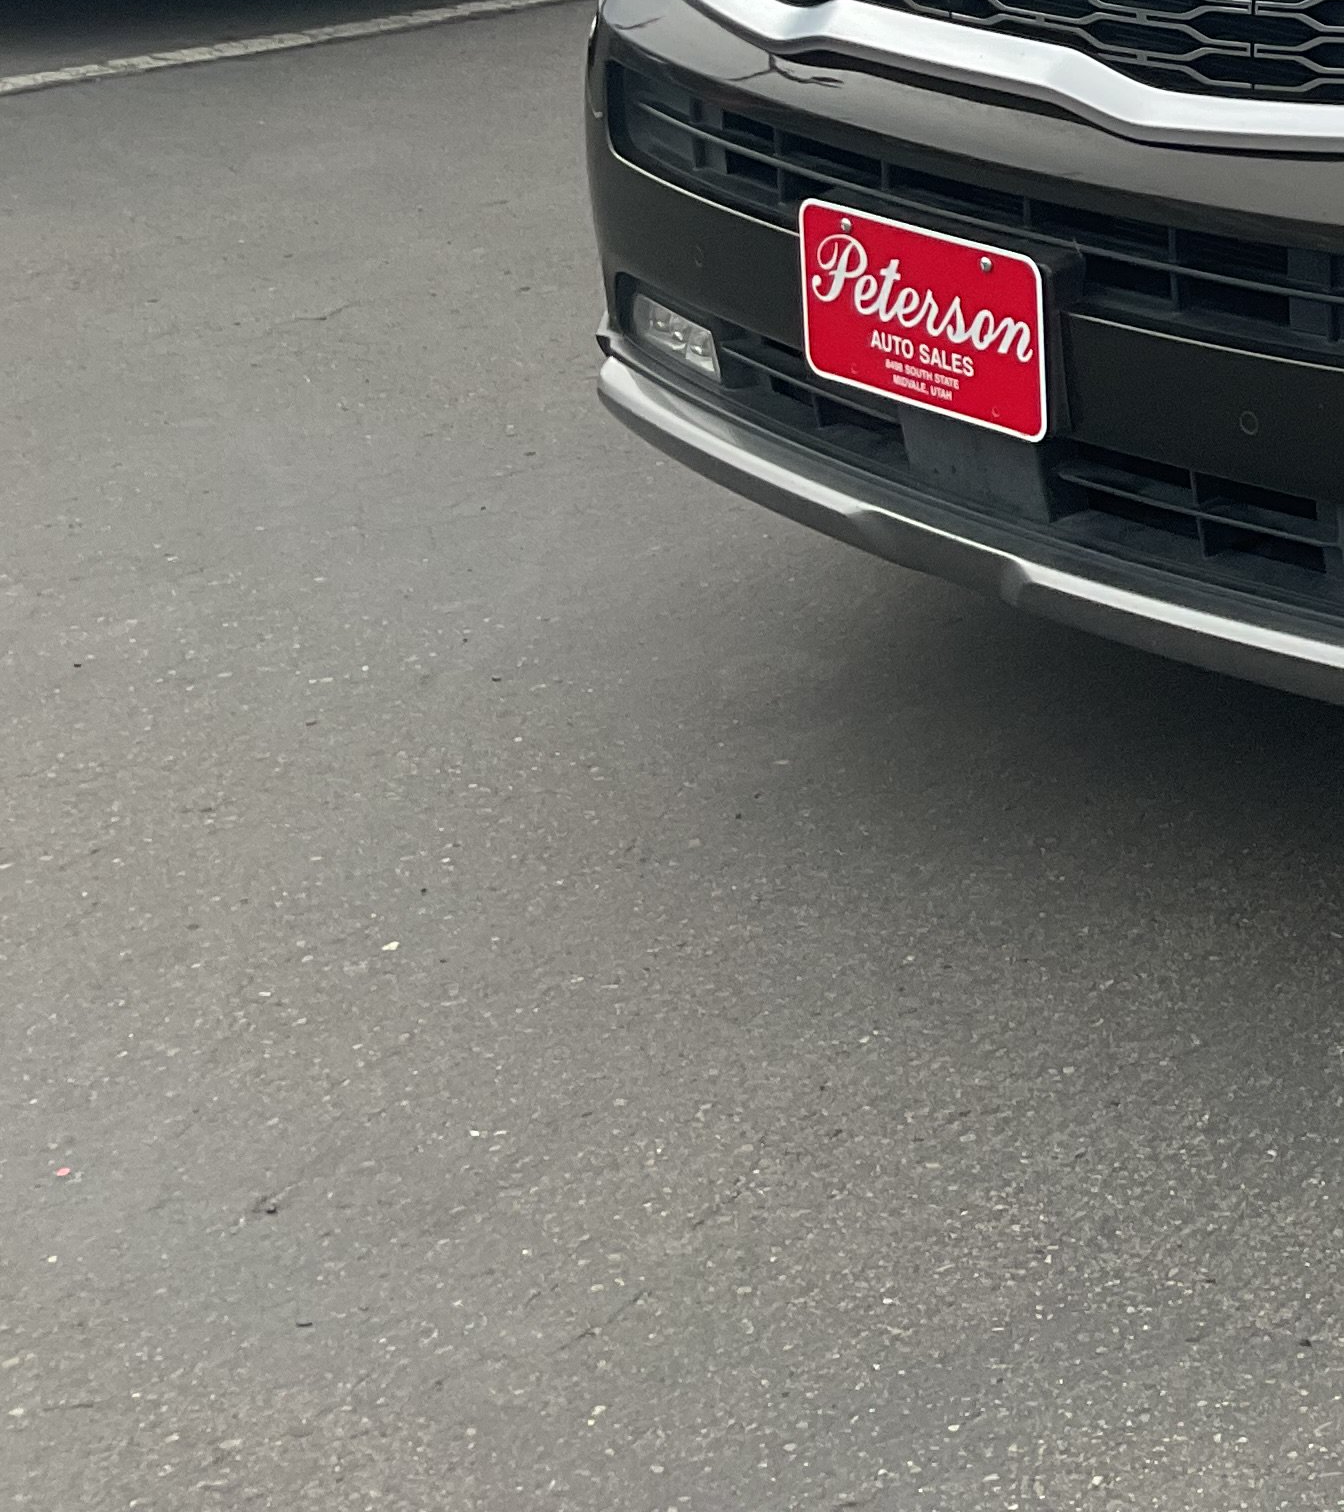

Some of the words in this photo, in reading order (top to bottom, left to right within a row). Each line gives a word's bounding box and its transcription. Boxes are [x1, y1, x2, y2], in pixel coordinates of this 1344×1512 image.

[812, 234, 1033, 362] Peterson
[870, 330, 914, 359] AUTO
[919, 344, 974, 377] SALES
[904, 364, 933, 381] SOUTH
[934, 373, 959, 390] STATE
[930, 385, 953, 401] UTAH
